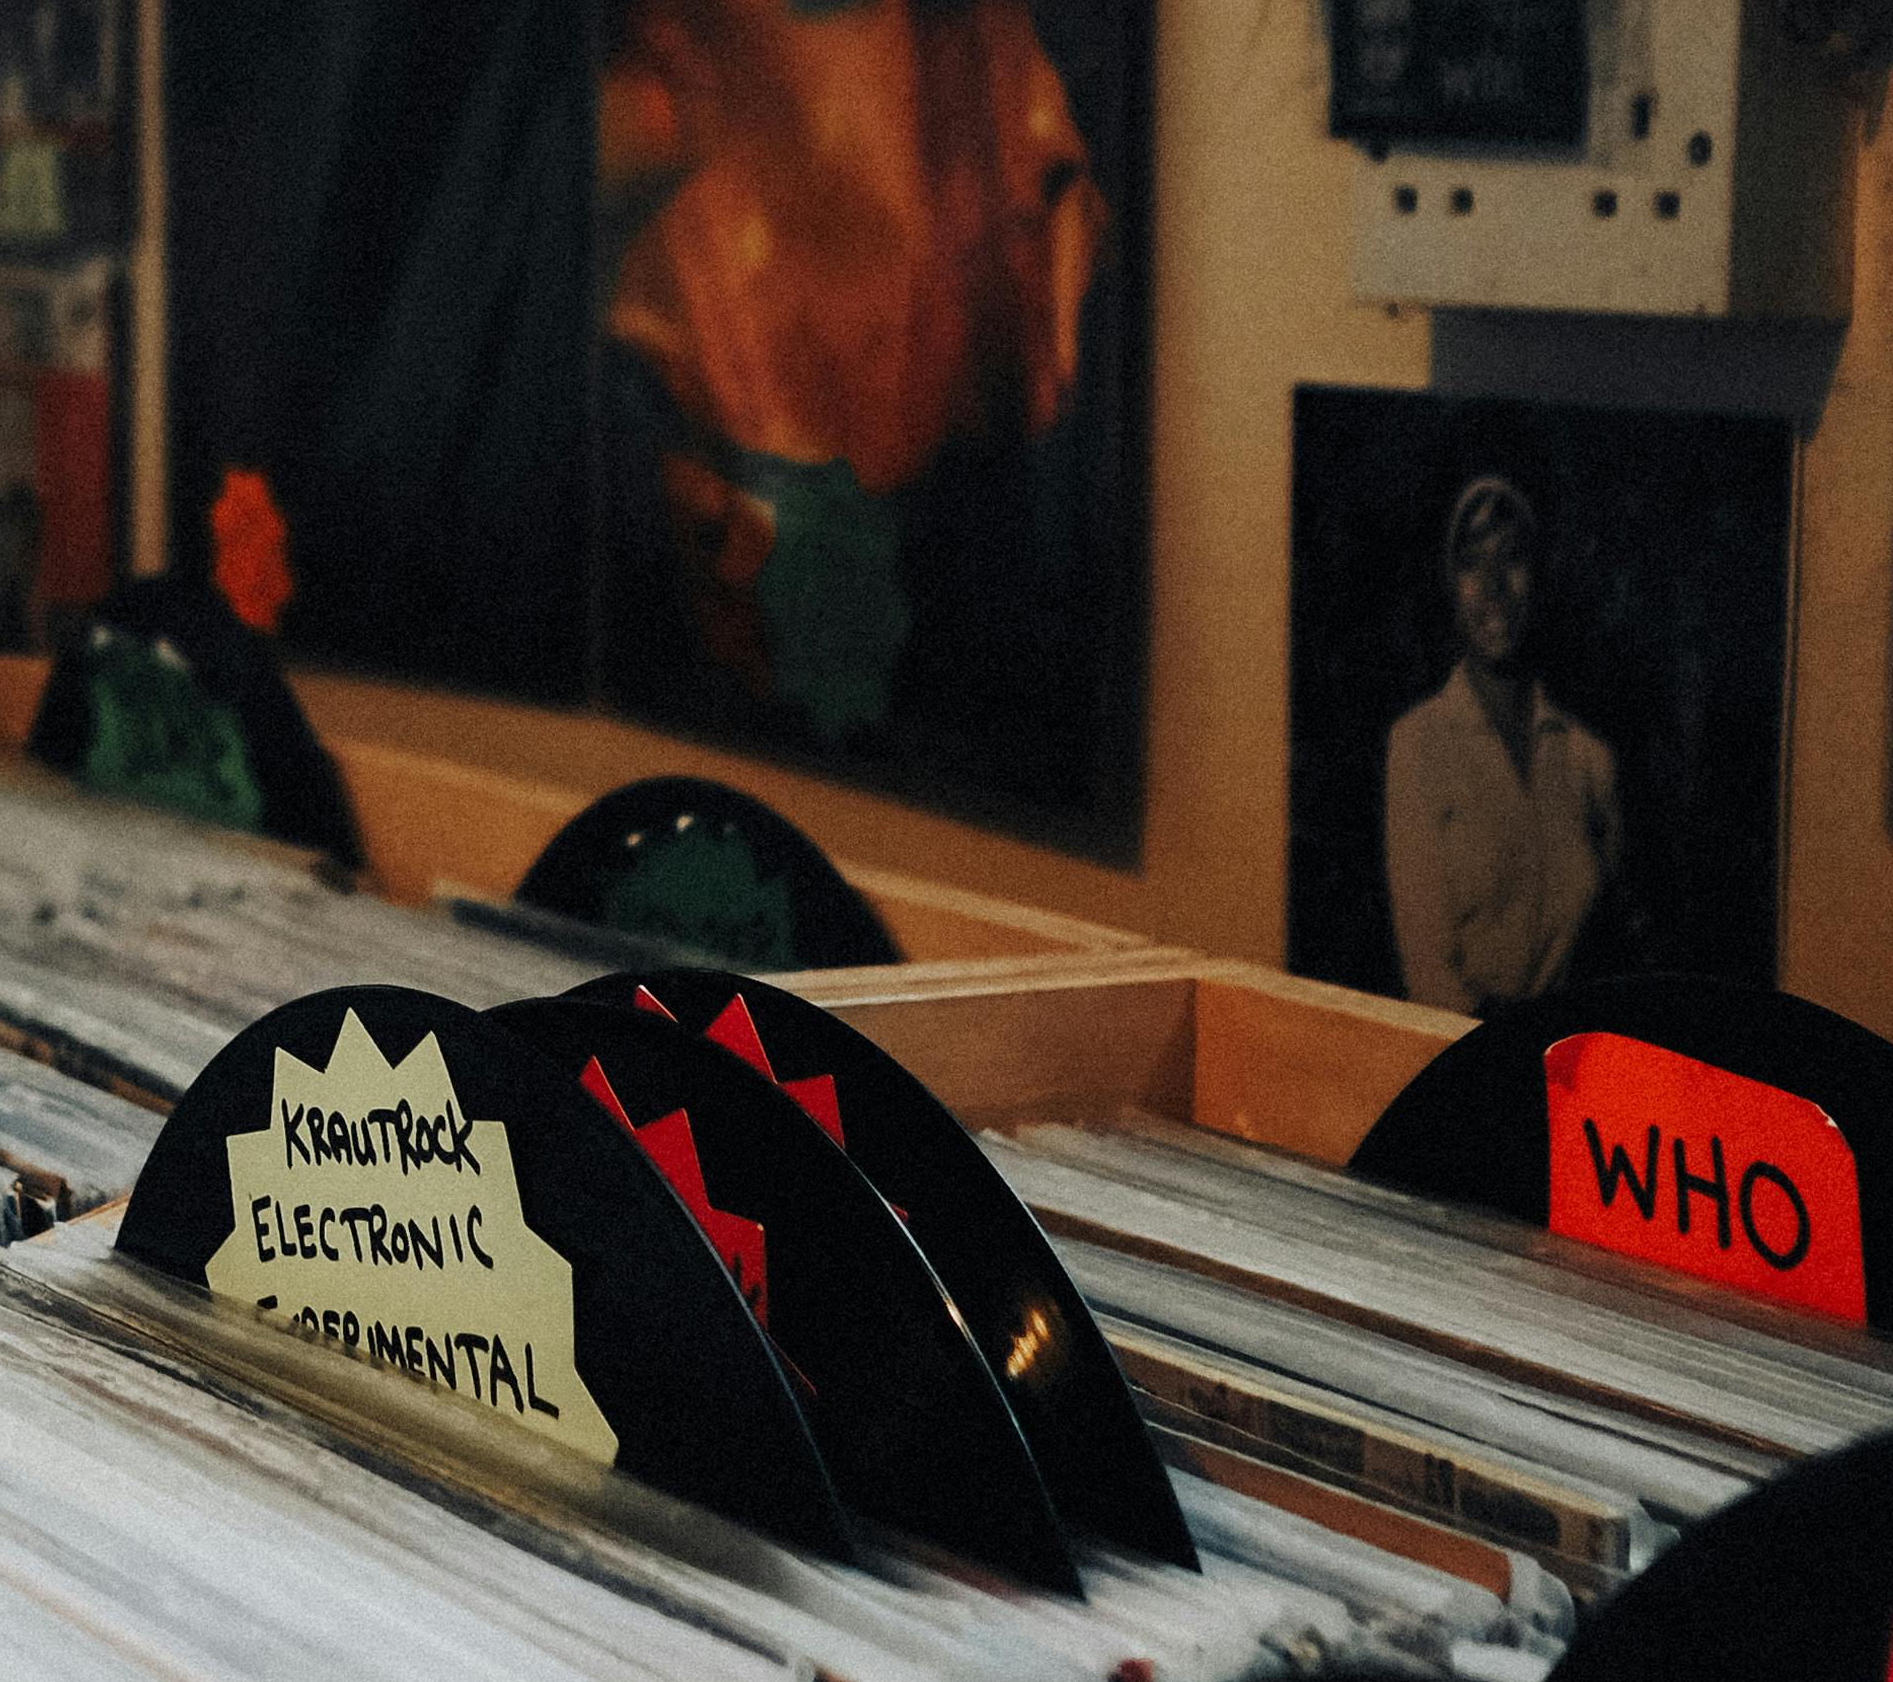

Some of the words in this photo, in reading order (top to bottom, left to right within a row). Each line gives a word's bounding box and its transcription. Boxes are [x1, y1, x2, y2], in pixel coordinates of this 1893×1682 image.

[281, 1098, 481, 1175] KRAUTROCK
[250, 1194, 495, 1270] ELECTRONIC
[1583, 1117, 1810, 1271] WHO
